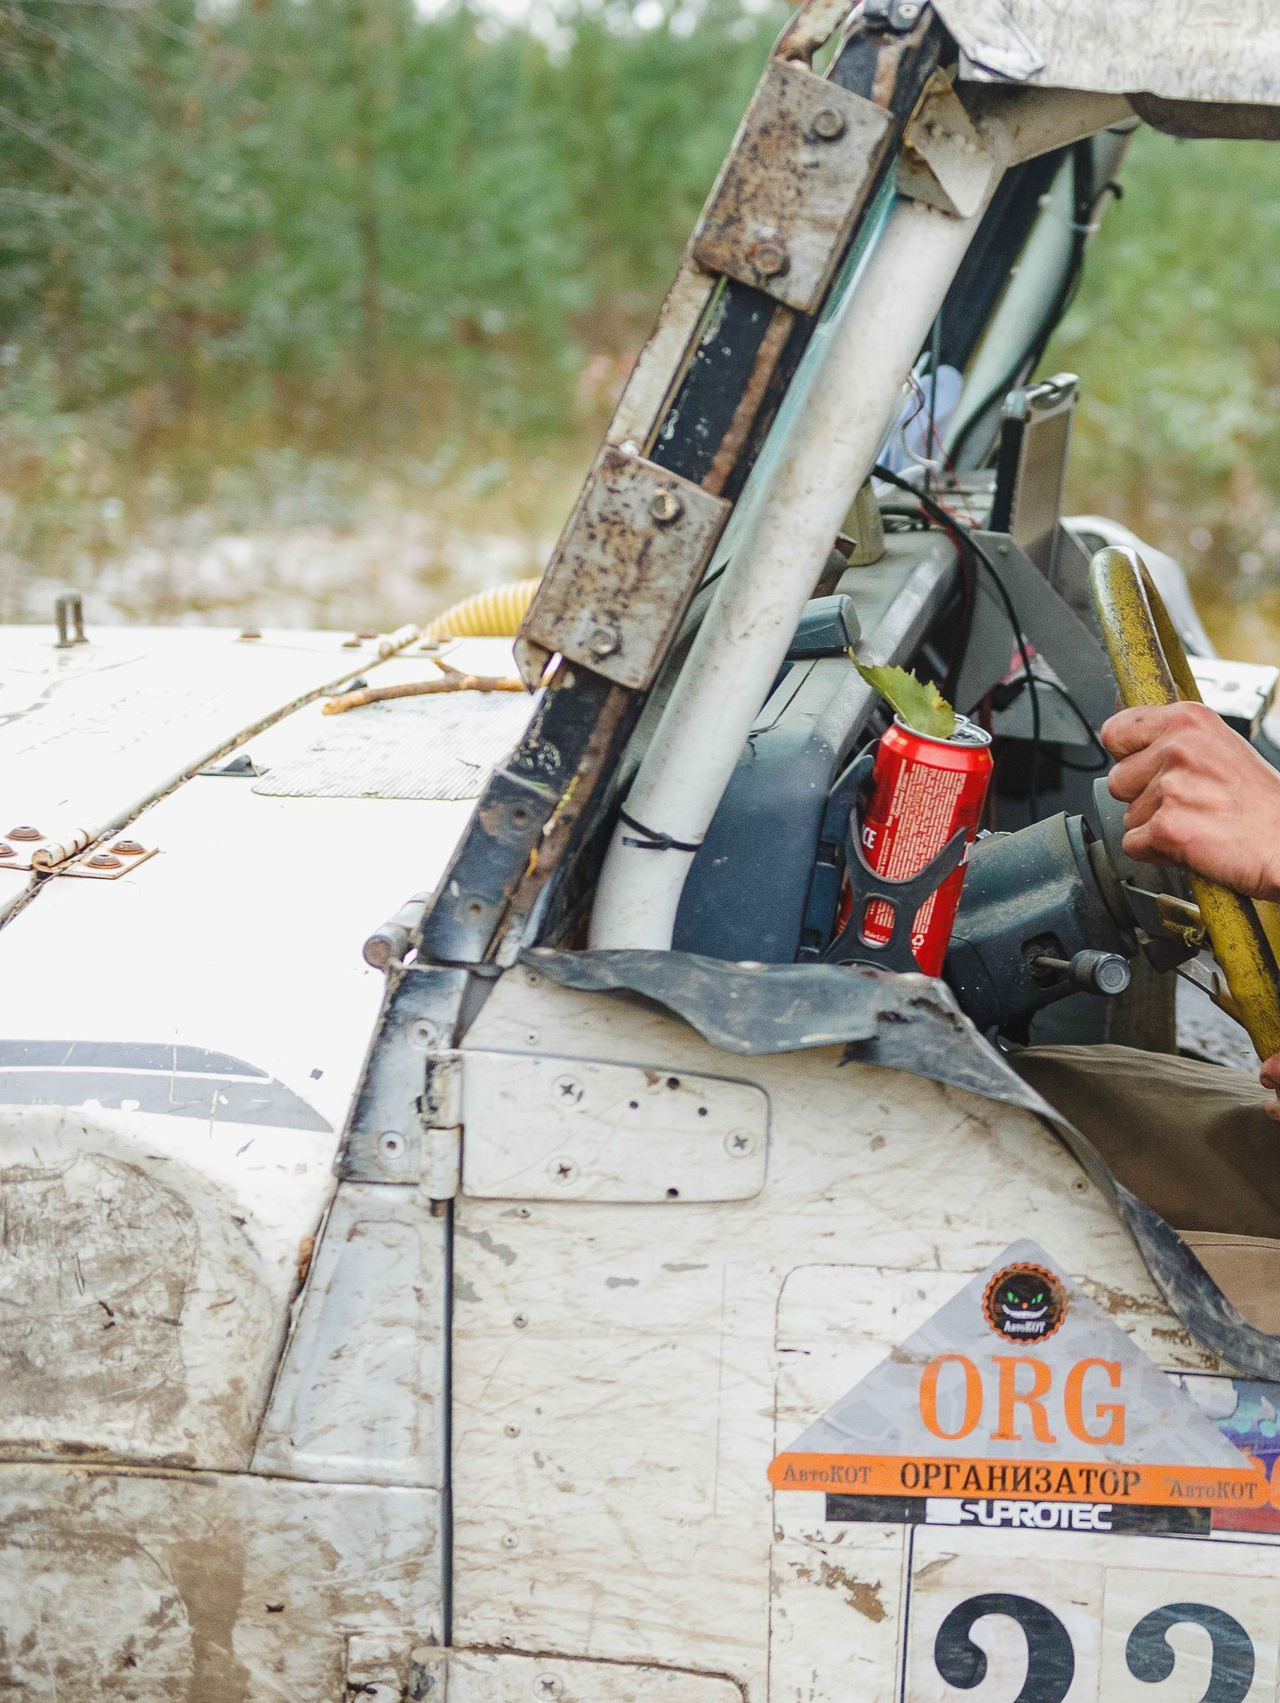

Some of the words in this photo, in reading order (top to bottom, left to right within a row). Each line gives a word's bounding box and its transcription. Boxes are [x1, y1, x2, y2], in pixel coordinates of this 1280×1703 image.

[919, 1353, 1126, 1446] ORG
[783, 1463, 873, 1484] АвтоКОТ
[900, 1461, 1141, 1497] ОРГАНИЗАТОР
[1168, 1478, 1258, 1500] АвтоКОТ
[959, 1500, 1113, 1531] SUPROTEC
